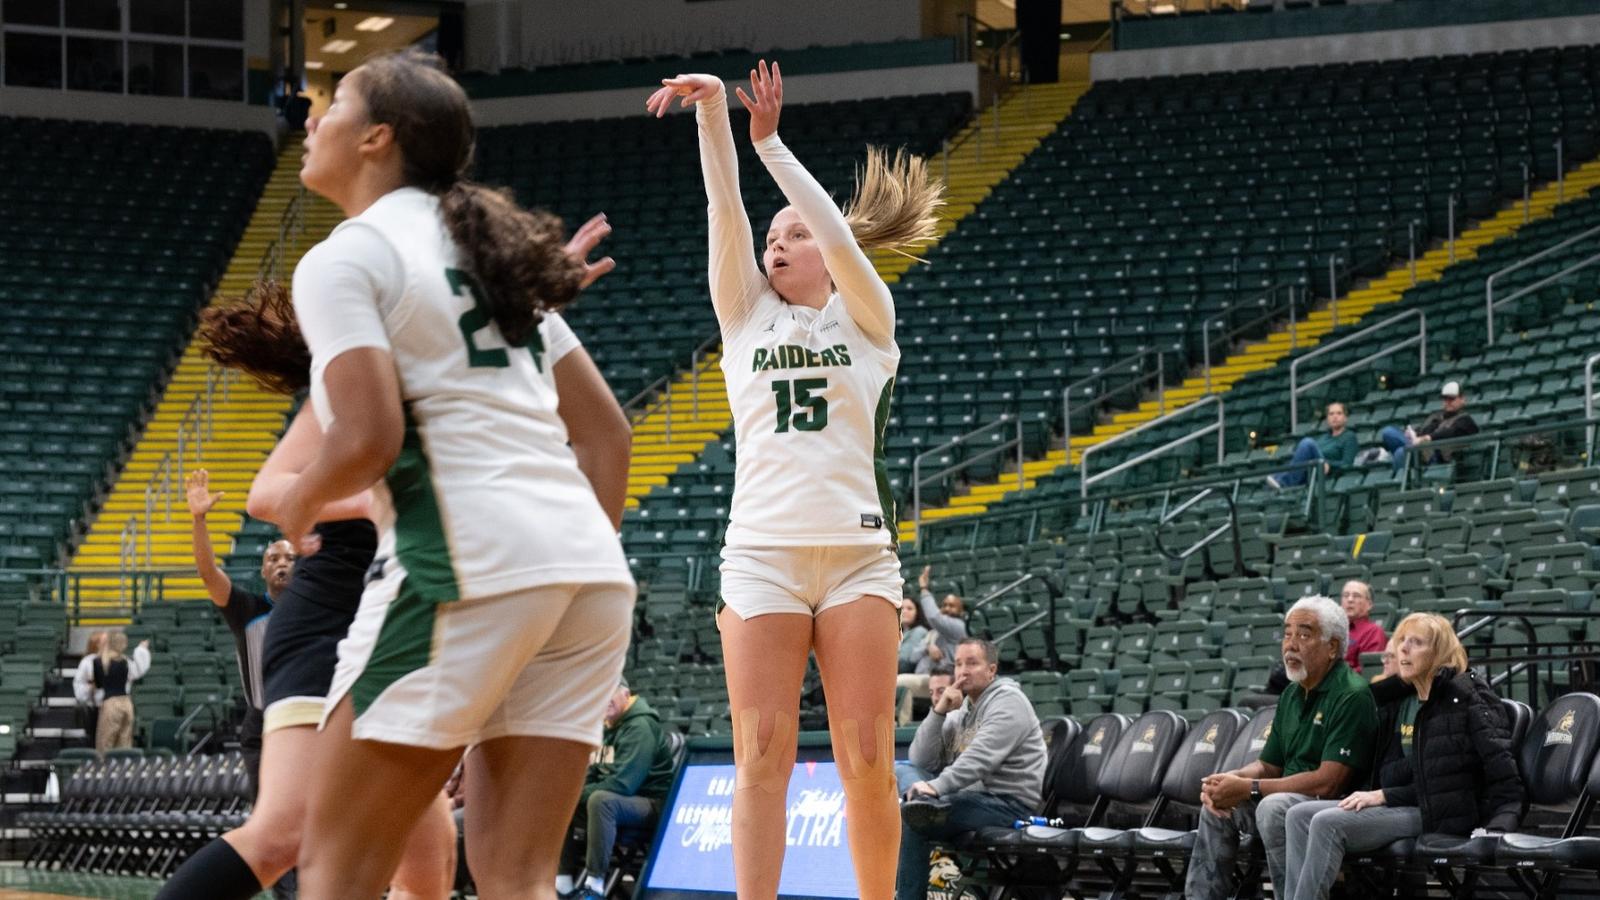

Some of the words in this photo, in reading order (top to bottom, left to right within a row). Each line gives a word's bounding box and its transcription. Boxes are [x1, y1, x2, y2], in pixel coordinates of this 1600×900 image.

[752, 344, 852, 372] RAIDERS
[771, 377, 828, 433] 15
[785, 812, 845, 847] LTRA
